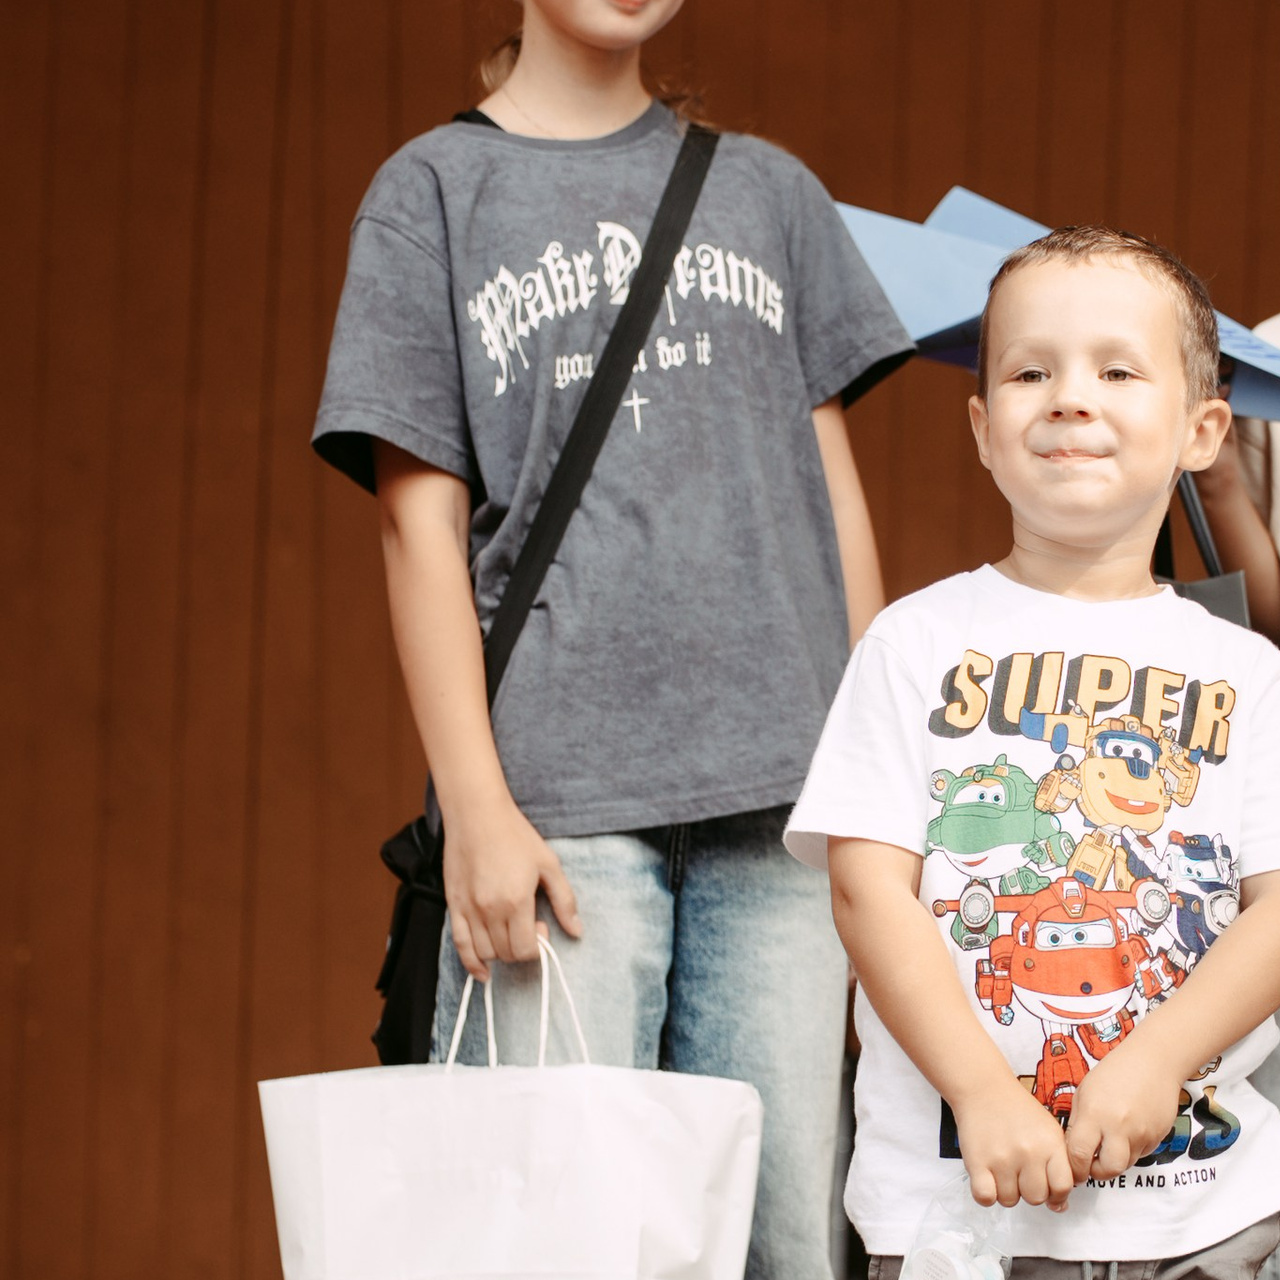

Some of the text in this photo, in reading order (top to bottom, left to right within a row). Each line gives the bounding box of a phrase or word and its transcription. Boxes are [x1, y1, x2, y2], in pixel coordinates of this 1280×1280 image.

[467, 221, 785, 397] Make Deams
[655, 335, 688, 371] do
[695, 331, 713, 367] it
[928, 648, 1236, 766] SUPER
[1135, 1174, 1166, 1188] AND
[1174, 1167, 1217, 1187] ACTION
